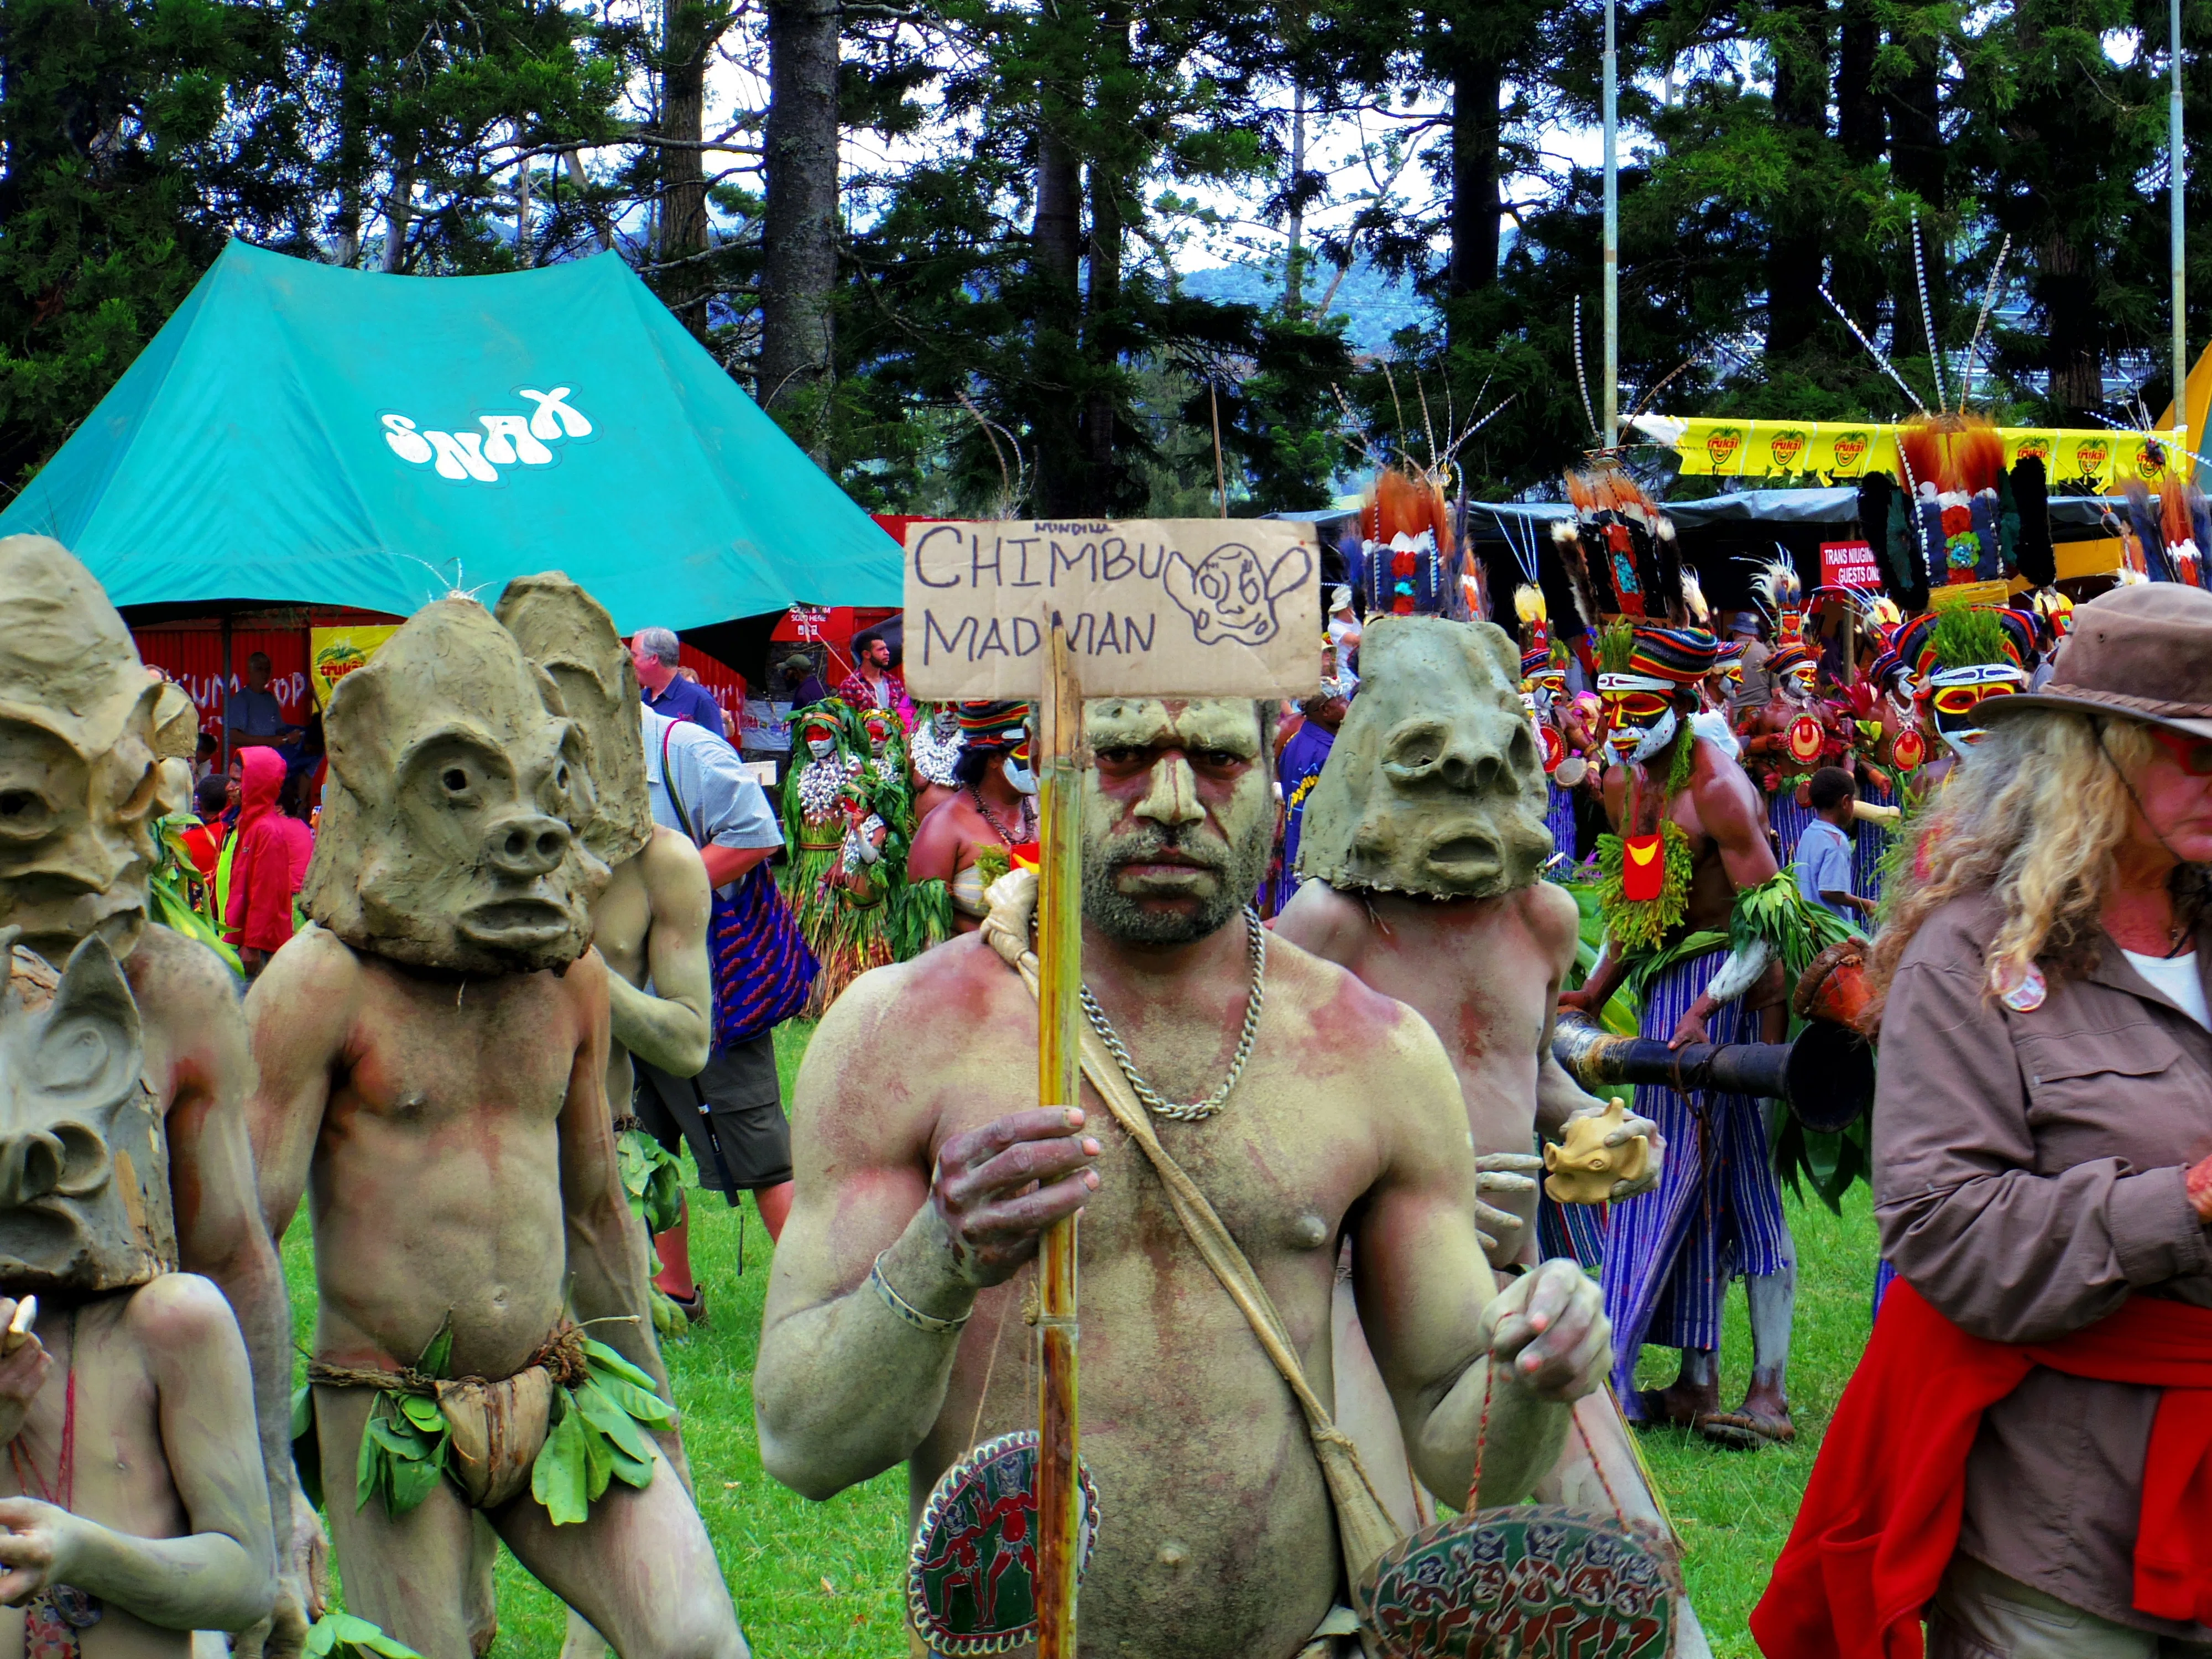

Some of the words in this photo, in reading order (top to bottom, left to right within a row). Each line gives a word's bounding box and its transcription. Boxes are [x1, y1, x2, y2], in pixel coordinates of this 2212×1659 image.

[382, 387, 592, 482] SNAX
[915, 526, 1164, 587] CHIMBU
[1824, 549, 1847, 565] TRANS
[1838, 566, 1865, 583] GUESTS
[1866, 565, 1880, 581] ONL
